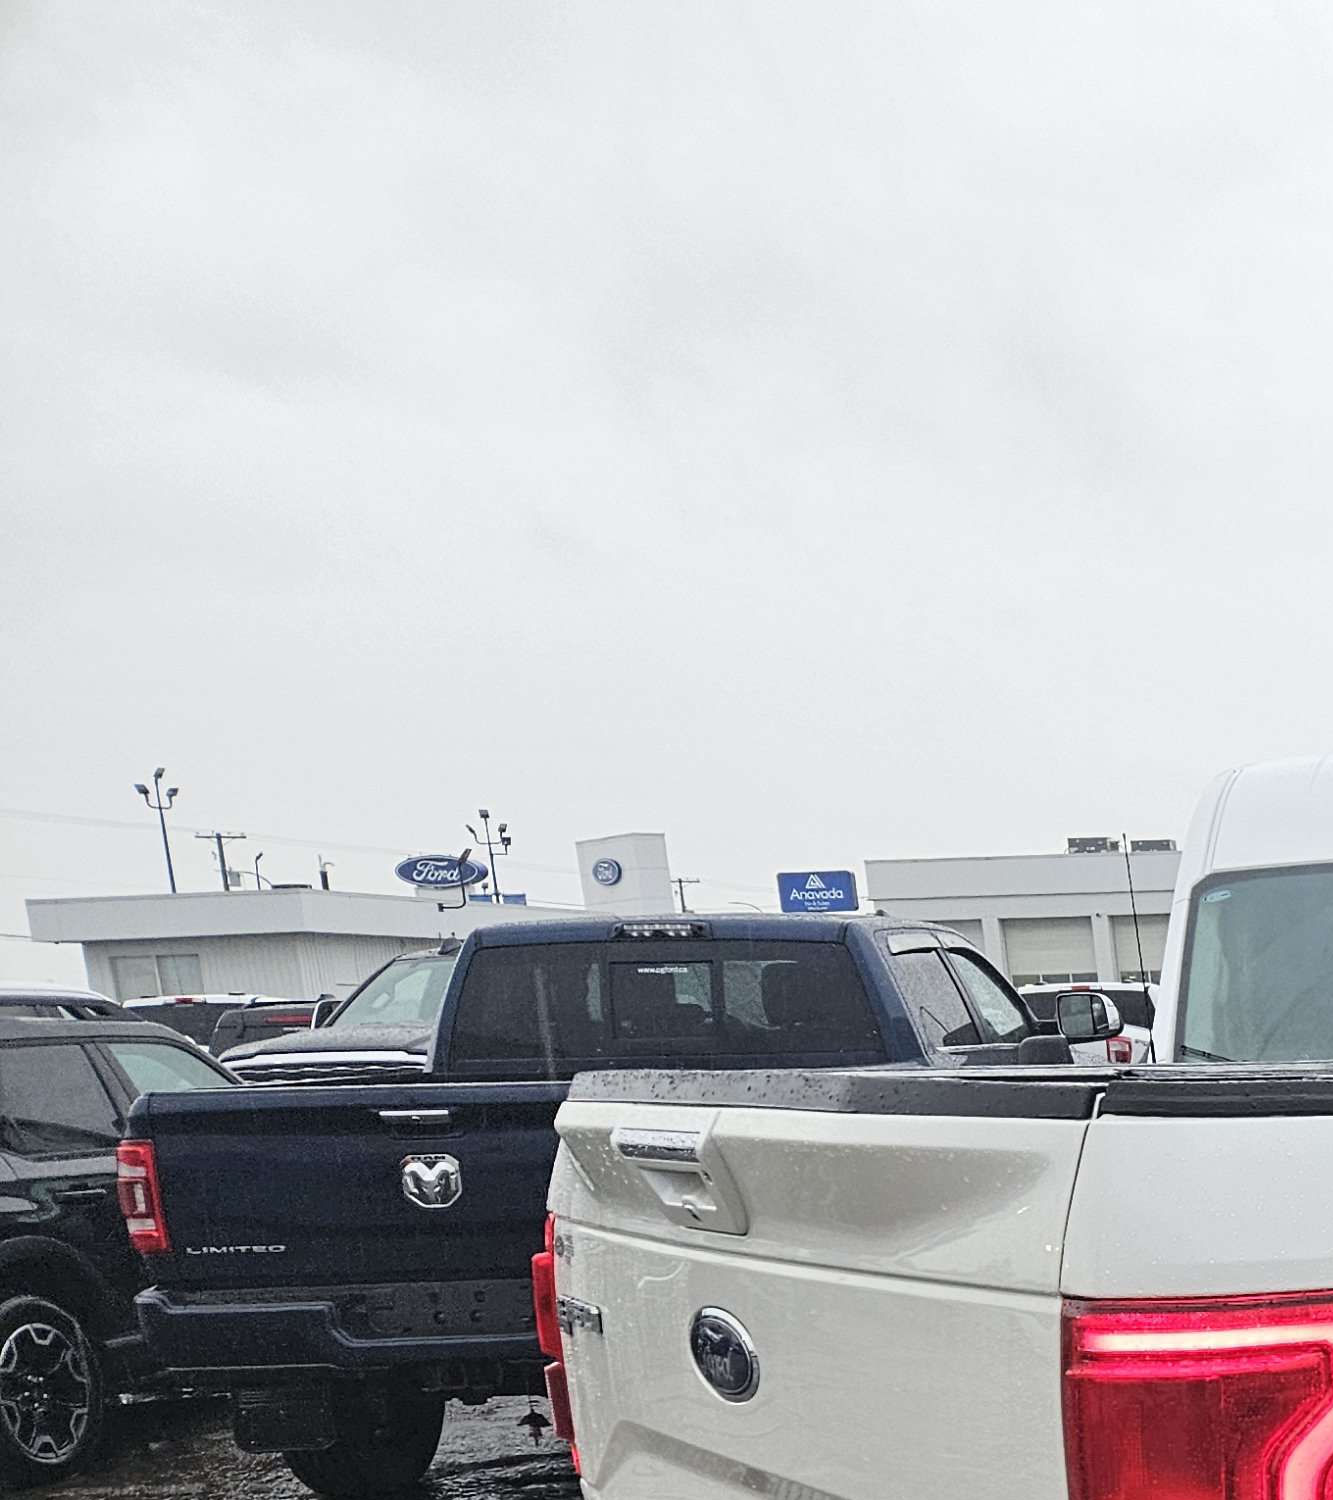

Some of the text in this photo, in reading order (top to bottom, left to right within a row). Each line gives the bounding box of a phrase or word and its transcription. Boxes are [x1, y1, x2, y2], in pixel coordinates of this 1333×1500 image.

[412, 860, 461, 881] Ford
[789, 887, 845, 901] Anavada
[185, 1244, 287, 1255] LIMITED
